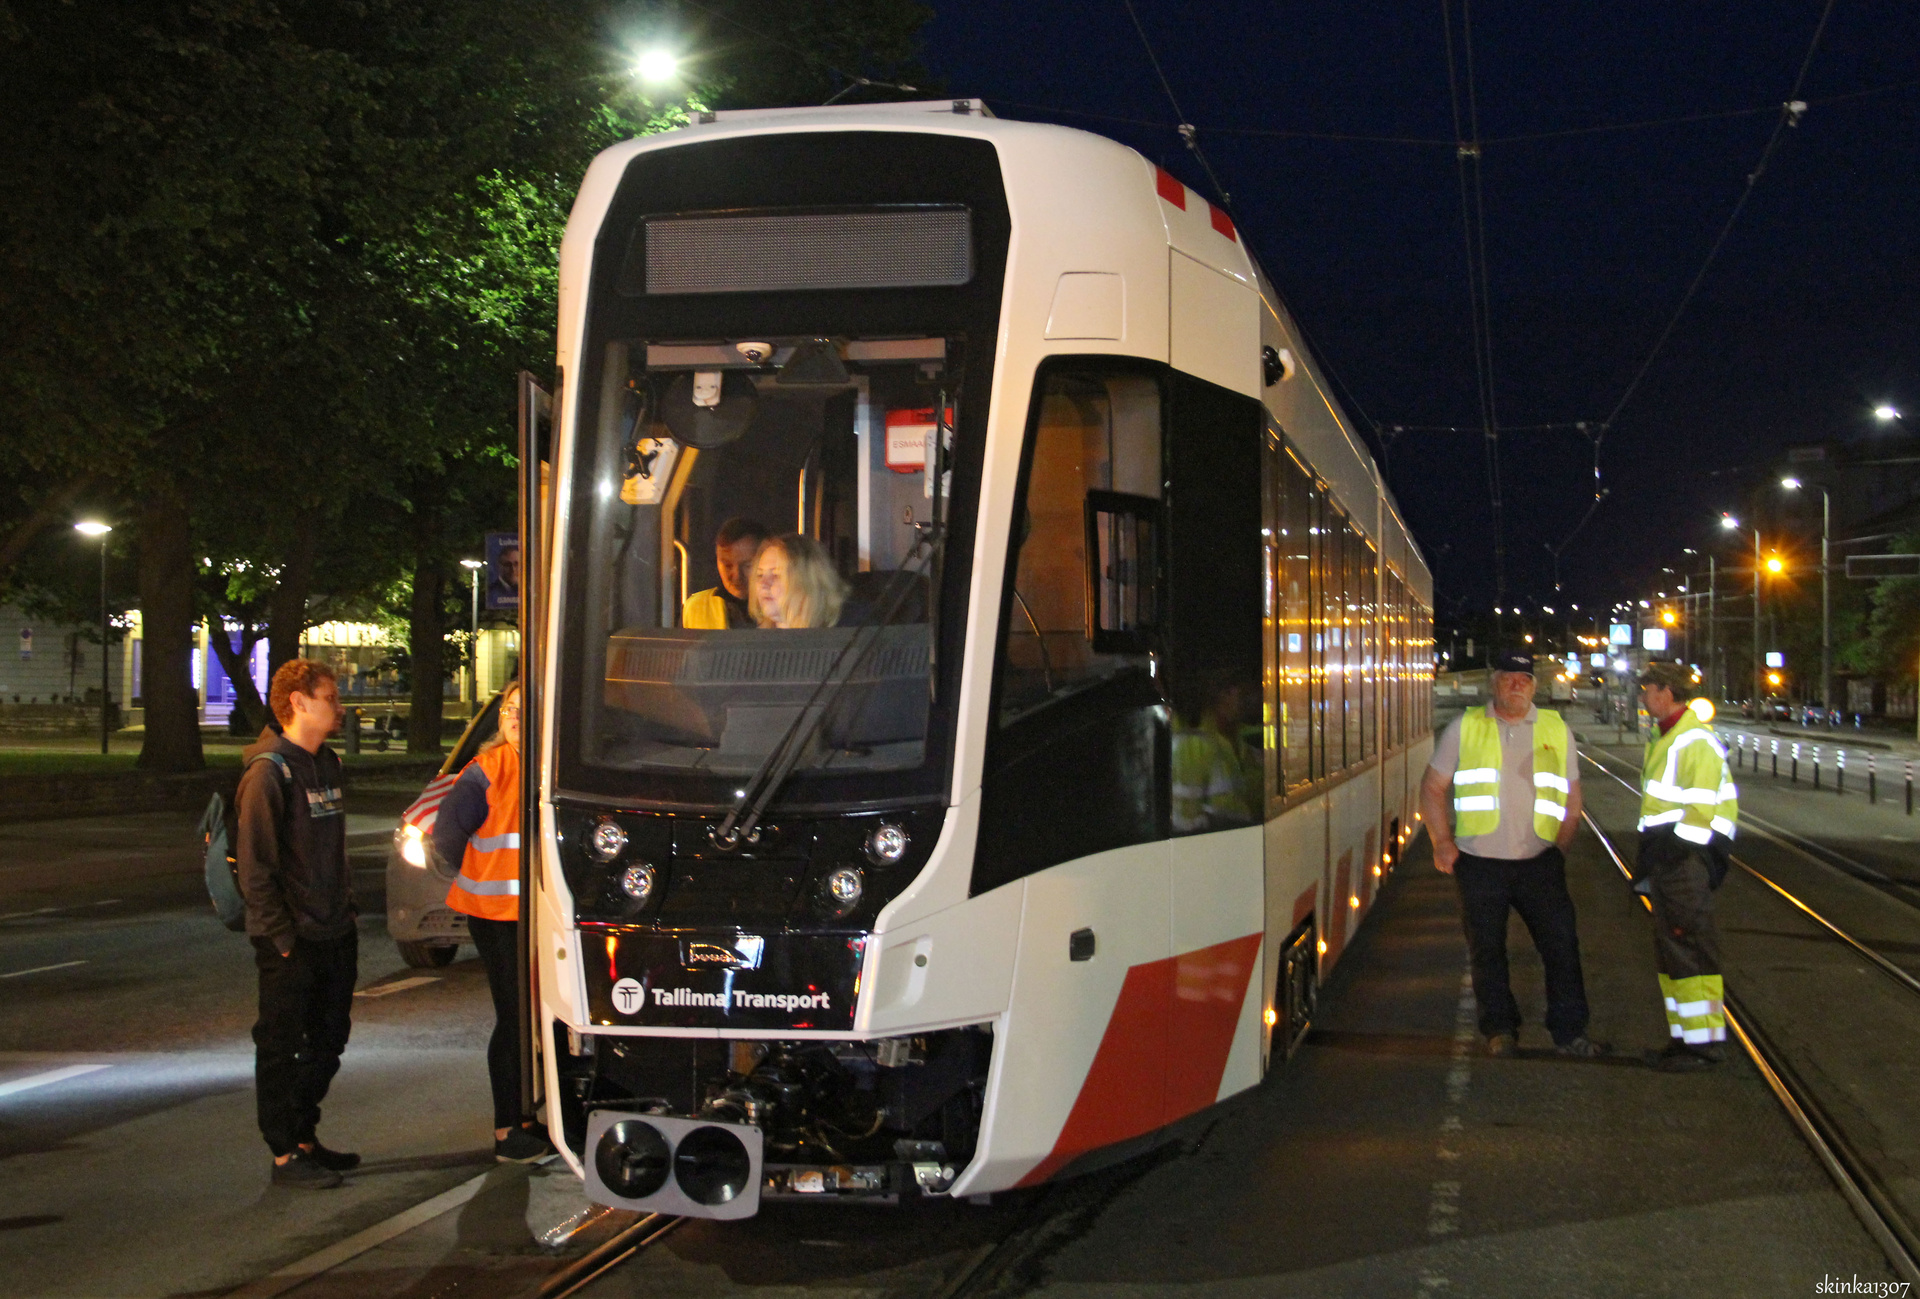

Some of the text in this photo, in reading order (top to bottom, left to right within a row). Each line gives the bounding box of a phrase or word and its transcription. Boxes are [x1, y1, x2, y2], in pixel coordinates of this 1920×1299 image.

[893, 440, 925, 449] ESMAA
[651, 987, 831, 1013] Tallinna Transport
